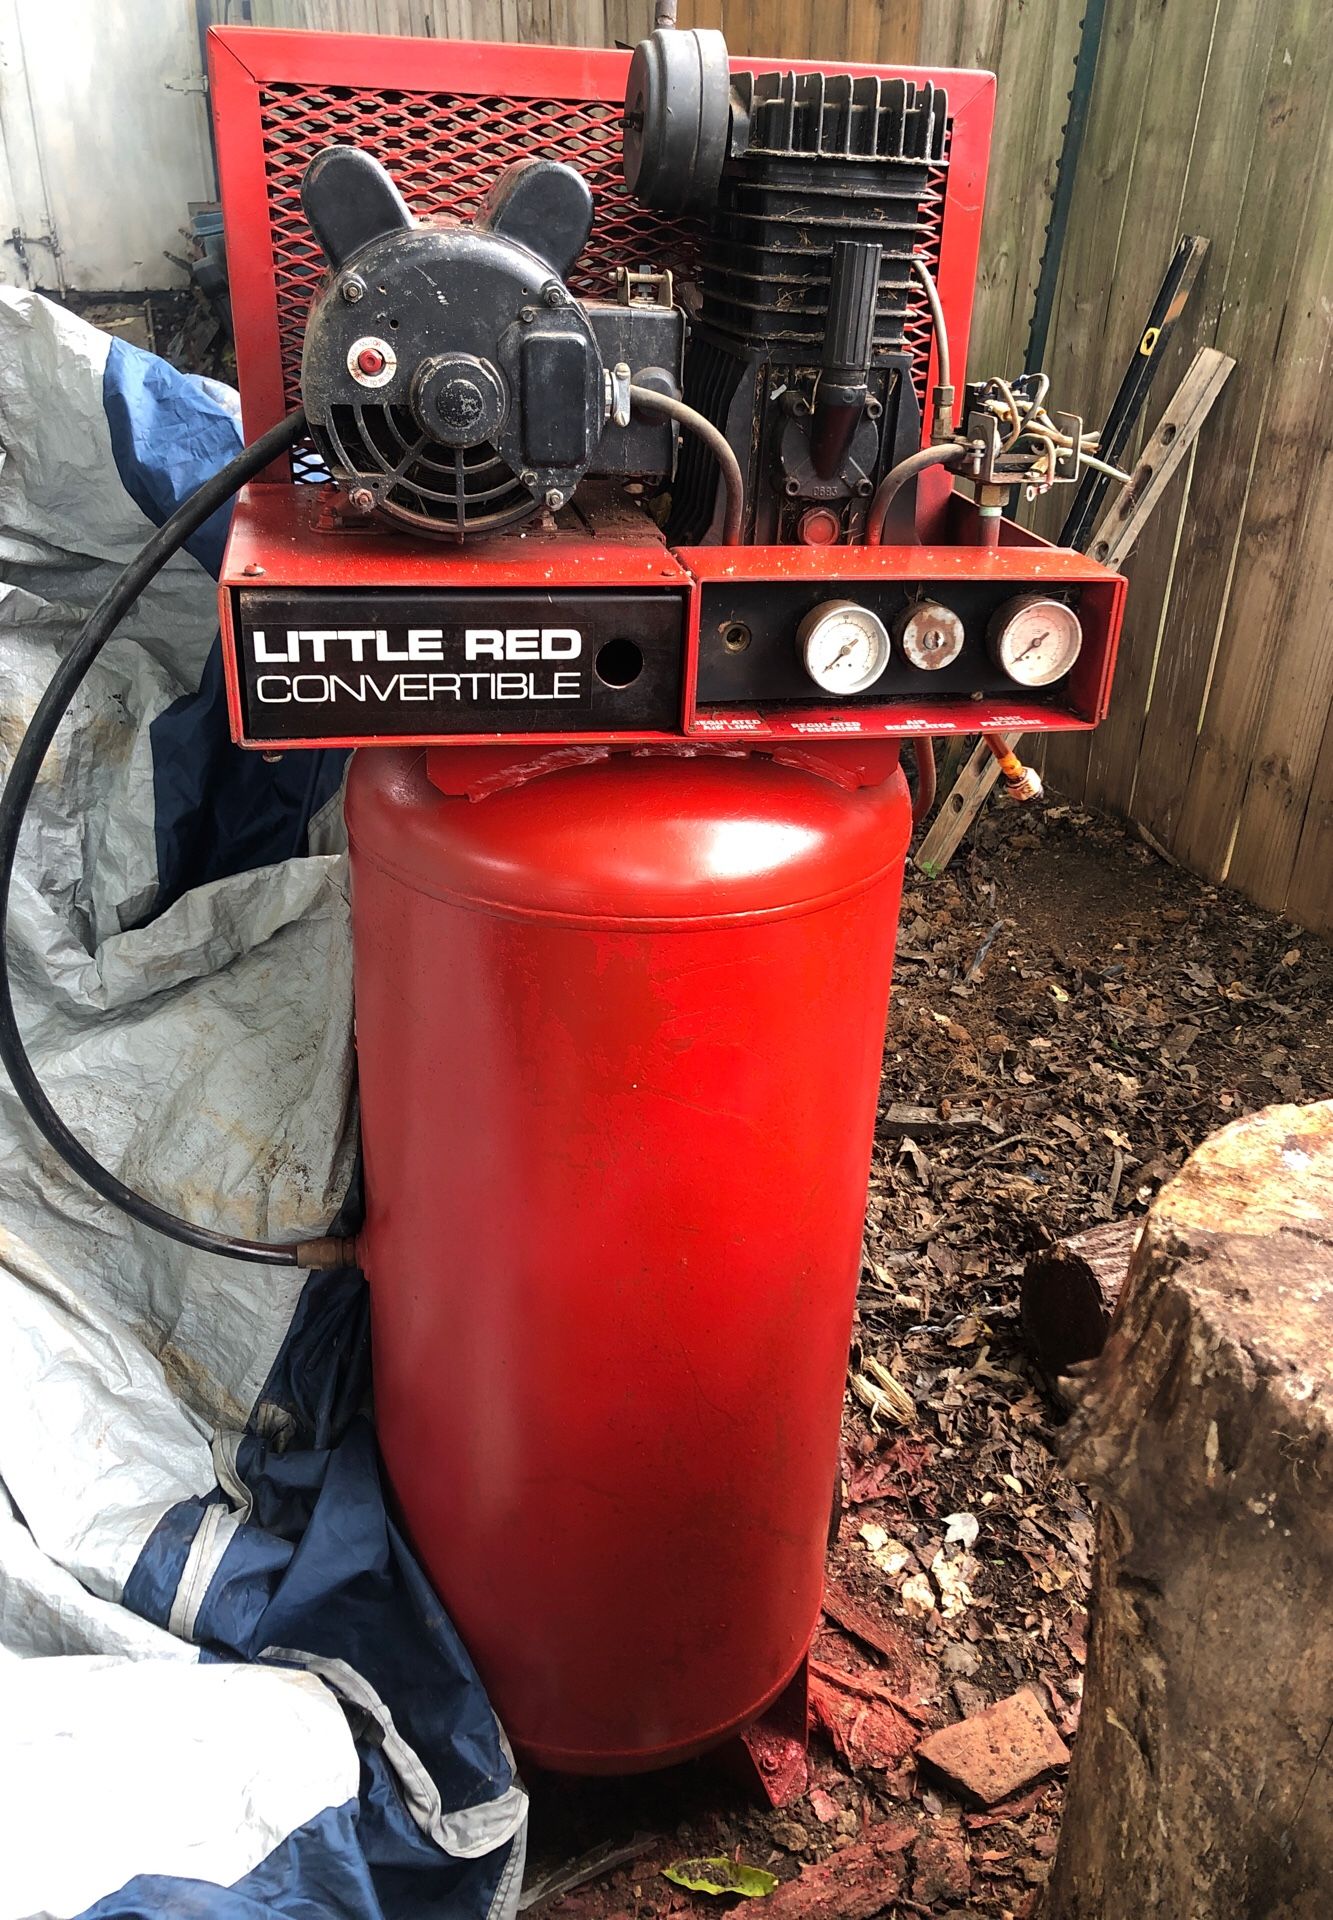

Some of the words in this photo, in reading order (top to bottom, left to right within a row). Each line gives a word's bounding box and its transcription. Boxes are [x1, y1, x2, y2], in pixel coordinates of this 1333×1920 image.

[253, 629, 444, 662] LITTLE
[465, 628, 582, 661] RED
[256, 672, 582, 703] CONVERTIBLE
